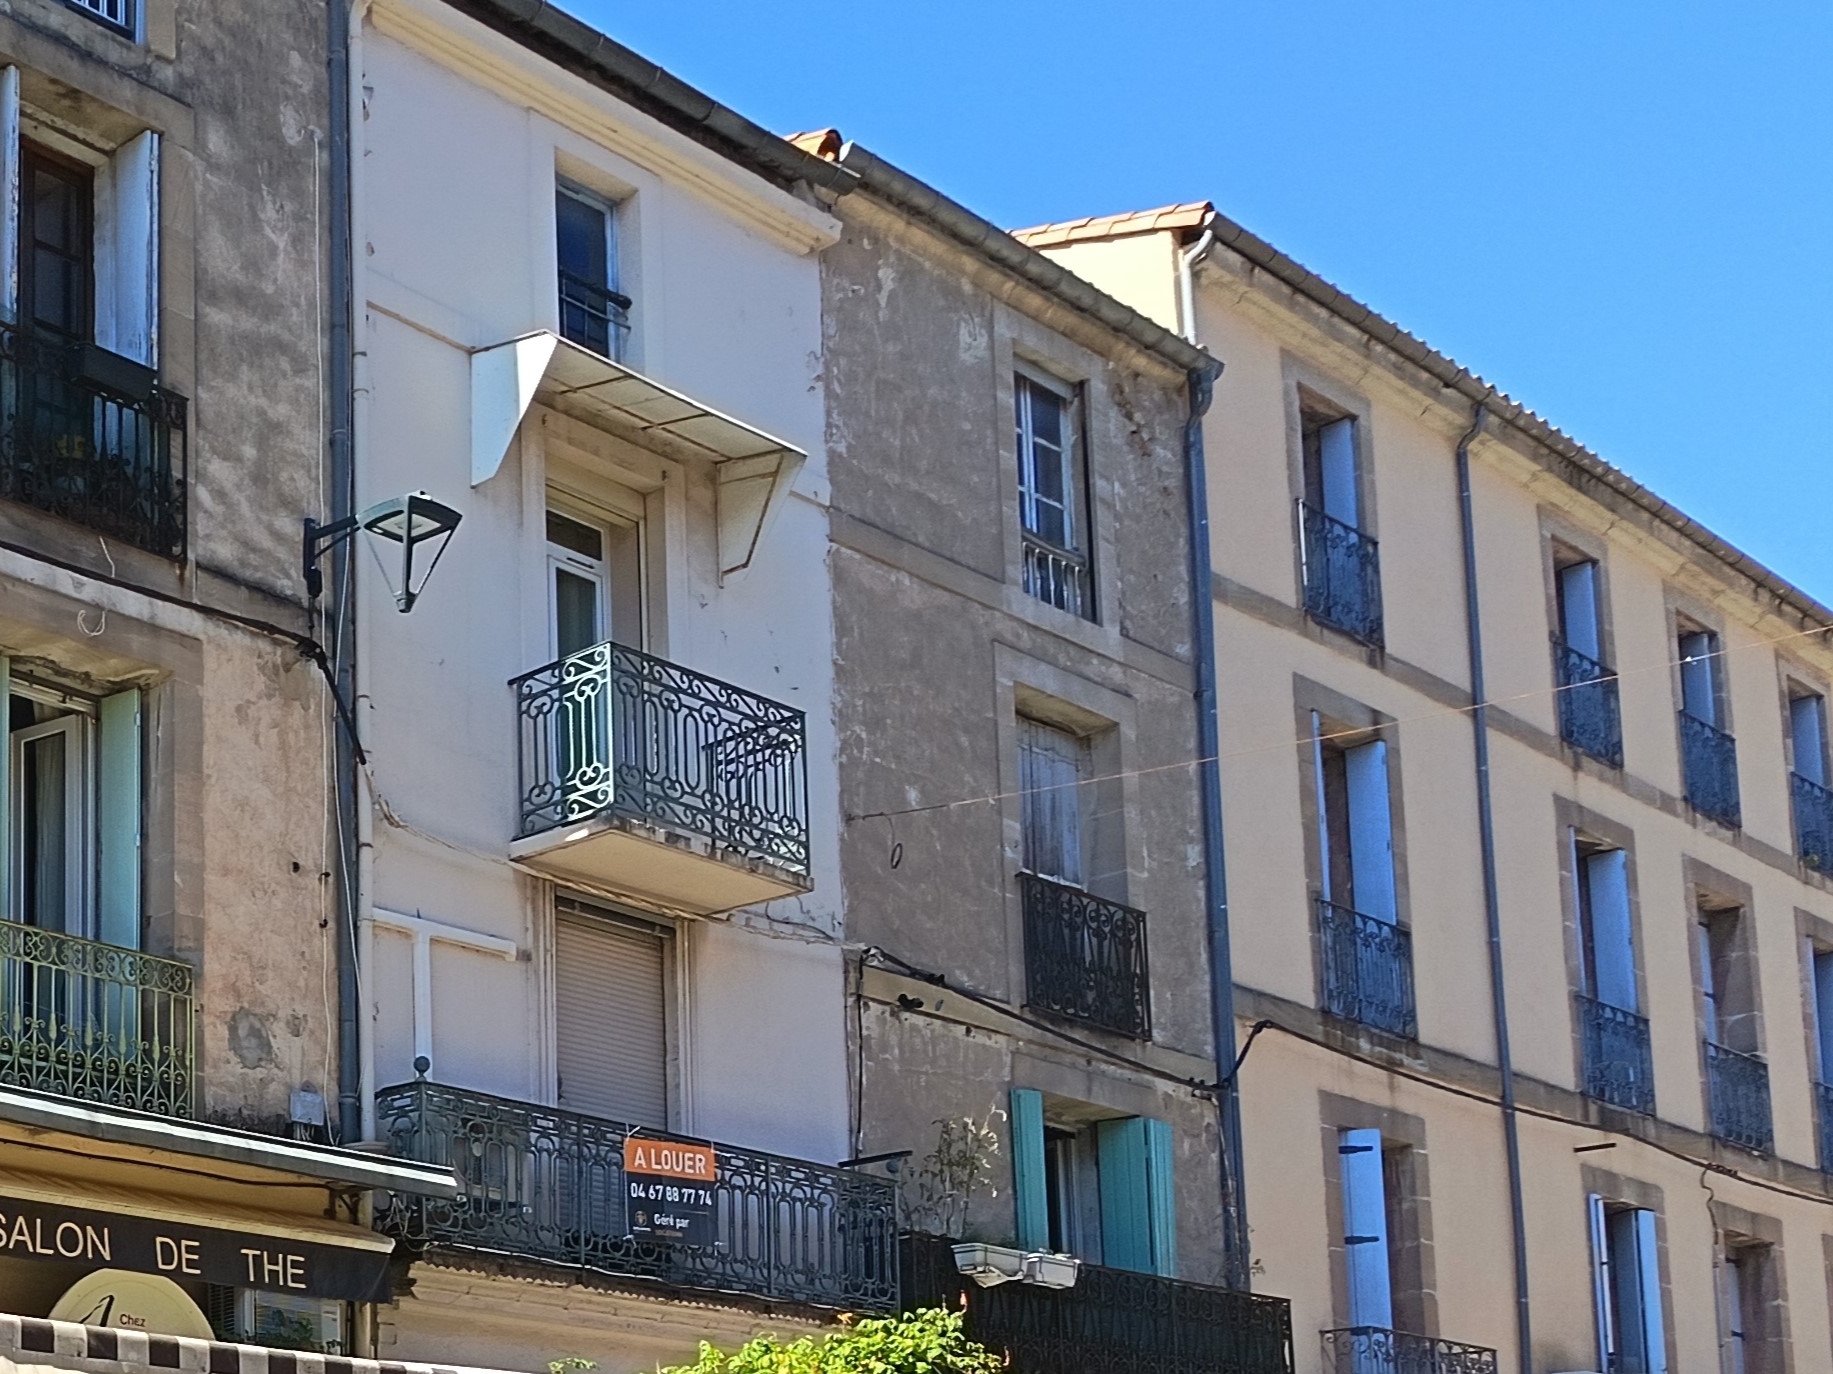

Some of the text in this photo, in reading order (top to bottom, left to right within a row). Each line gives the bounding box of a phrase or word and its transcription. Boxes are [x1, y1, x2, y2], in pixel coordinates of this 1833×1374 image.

[634, 1147, 705, 1174] A LOUER
[630, 1182, 646, 1198] 04
[648, 1184, 663, 1200] 67
[155, 1236, 201, 1274] DE
[240, 1249, 306, 1289] THE
[119, 1313, 146, 1327] Chez
